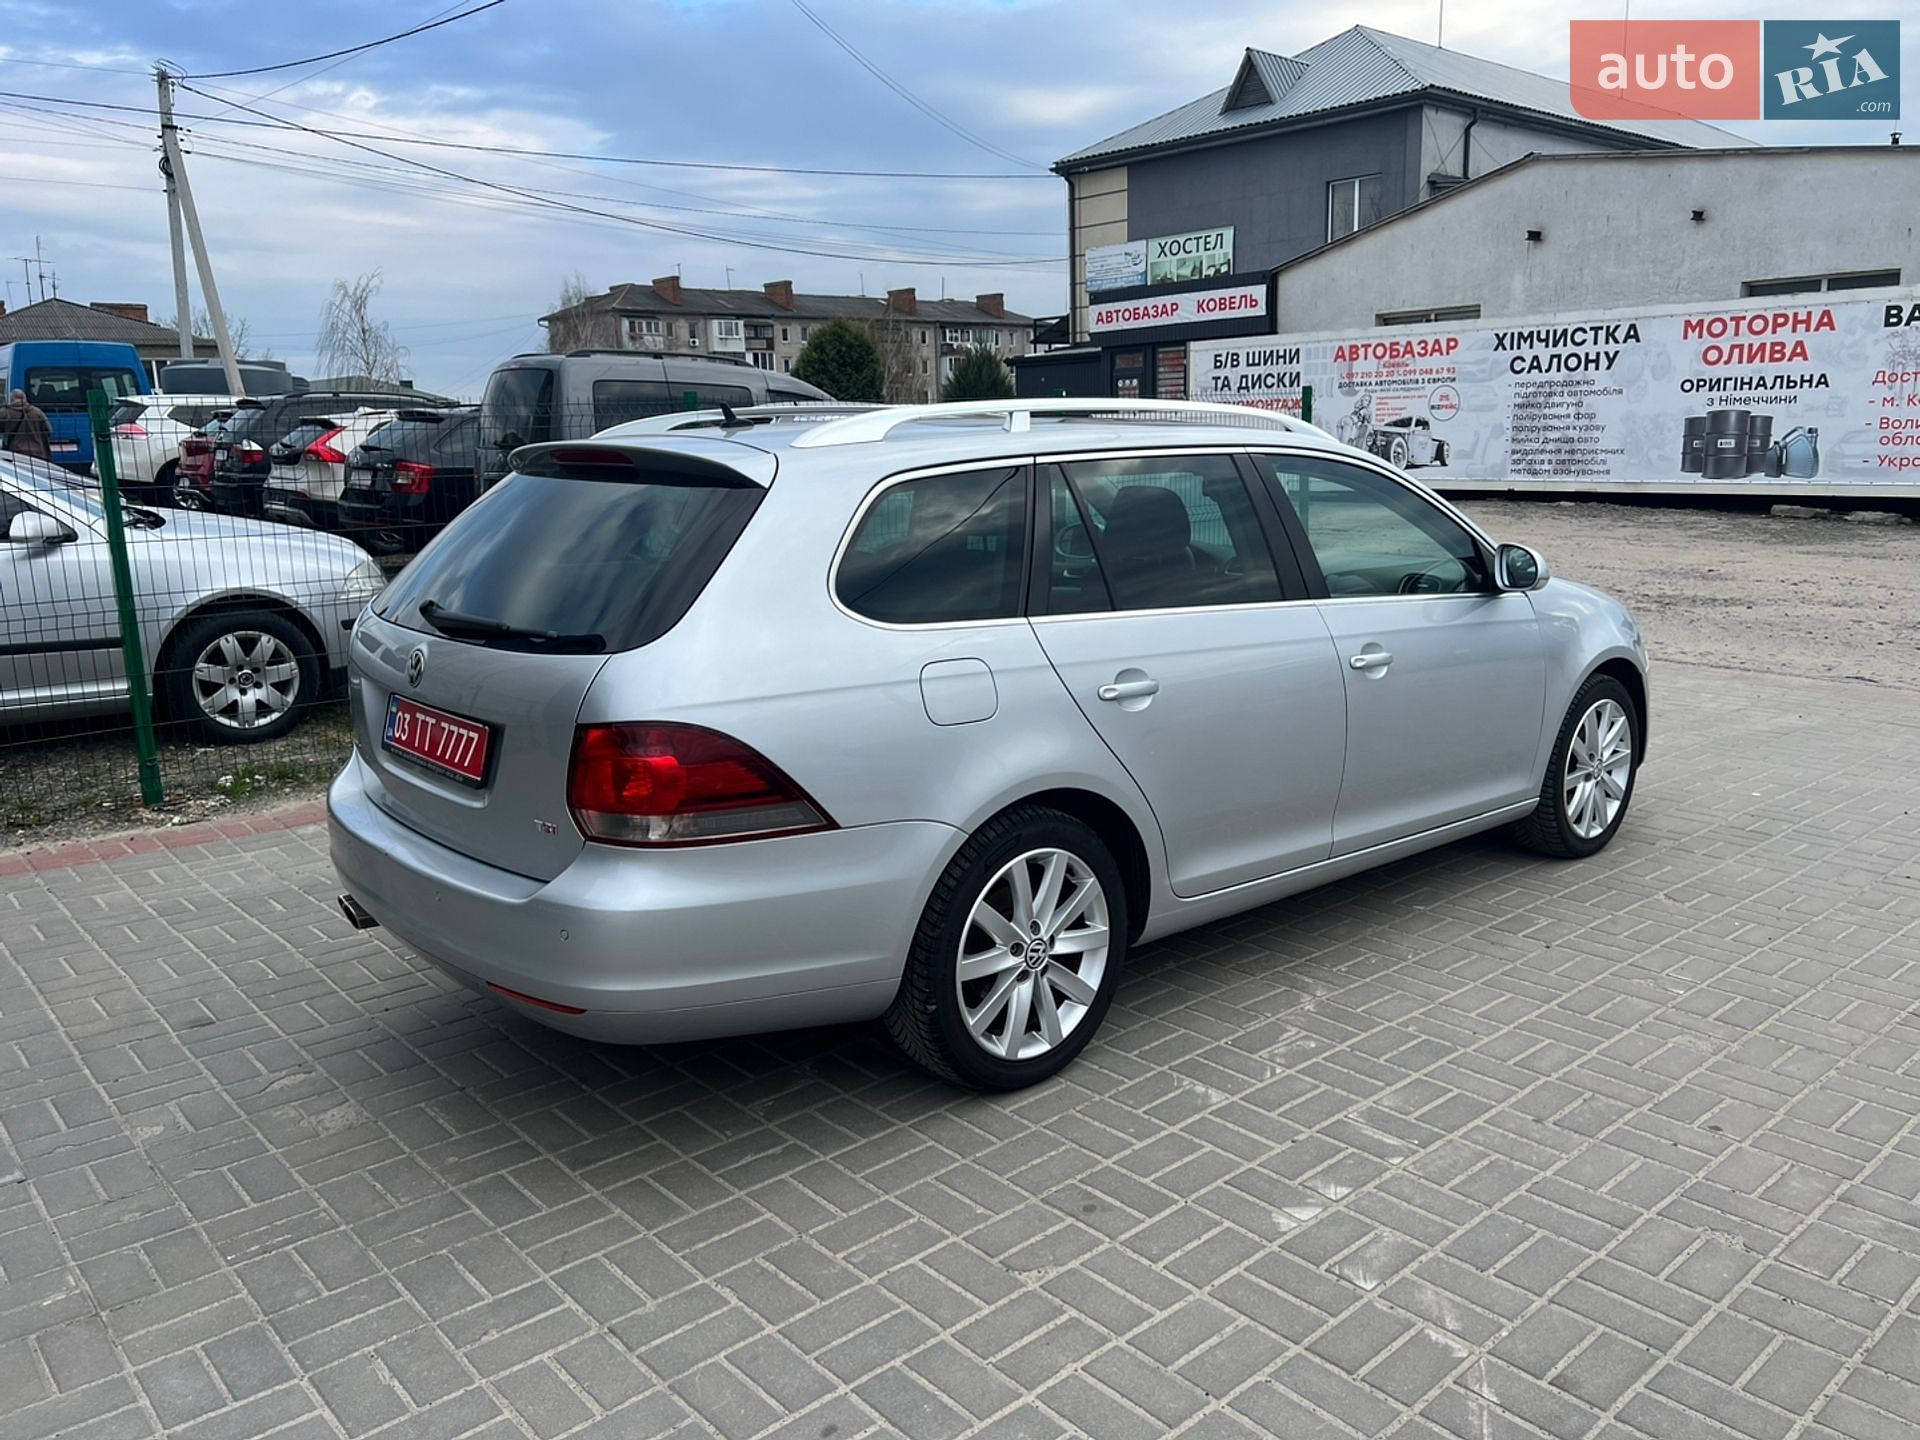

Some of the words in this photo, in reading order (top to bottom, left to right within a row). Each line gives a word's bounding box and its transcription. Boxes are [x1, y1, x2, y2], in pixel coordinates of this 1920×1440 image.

[1157, 232, 1224, 258] ХОСТЕЛ
[1095, 302, 1180, 325] АВТОБАЗАР
[1197, 294, 1259, 314] КОВЕЛЬ
[1682, 309, 1836, 340] МОТОРНА
[1493, 323, 1641, 351] ХІМЧИСТКА
[1213, 351, 1240, 369] Б/В
[1246, 347, 1300, 367] ШИНИ
[1334, 337, 1459, 362] АВТОБАЗАР
[1702, 340, 1809, 366] ОЛИВА
[1509, 350, 1620, 375] САЛОНУ
[1212, 375, 1231, 392] ТА
[1237, 371, 1301, 393] ДИСКИ
[1337, 381, 1373, 389] ДОСТАВКА
[1514, 378, 1596, 390] передпродажна
[1680, 373, 1830, 393] ОРИГІНАЛЬНА
[1513, 390, 1564, 399] підготовка
[1566, 387, 1624, 396] автомобіля
[1706, 397, 1714, 407] з
[1718, 394, 1798, 407] Німеччини
[1513, 400, 1542, 410] мийка
[1543, 400, 1584, 410] двигуна
[1512, 412, 1571, 422] полірування
[1573, 411, 1597, 422] фар
[1512, 425, 1571, 434] полірування
[1572, 424, 1607, 433] кузову
[1511, 435, 1540, 443] мийка
[1541, 437, 1575, 445] днища
[1577, 436, 1600, 444] авто
[1510, 448, 1562, 457] видалення
[1510, 468, 1551, 476] методом
[1553, 467, 1611, 477] озонування
[394, 711, 411, 741] 03
[415, 712, 437, 752] TT
[436, 721, 479, 767] 7777
